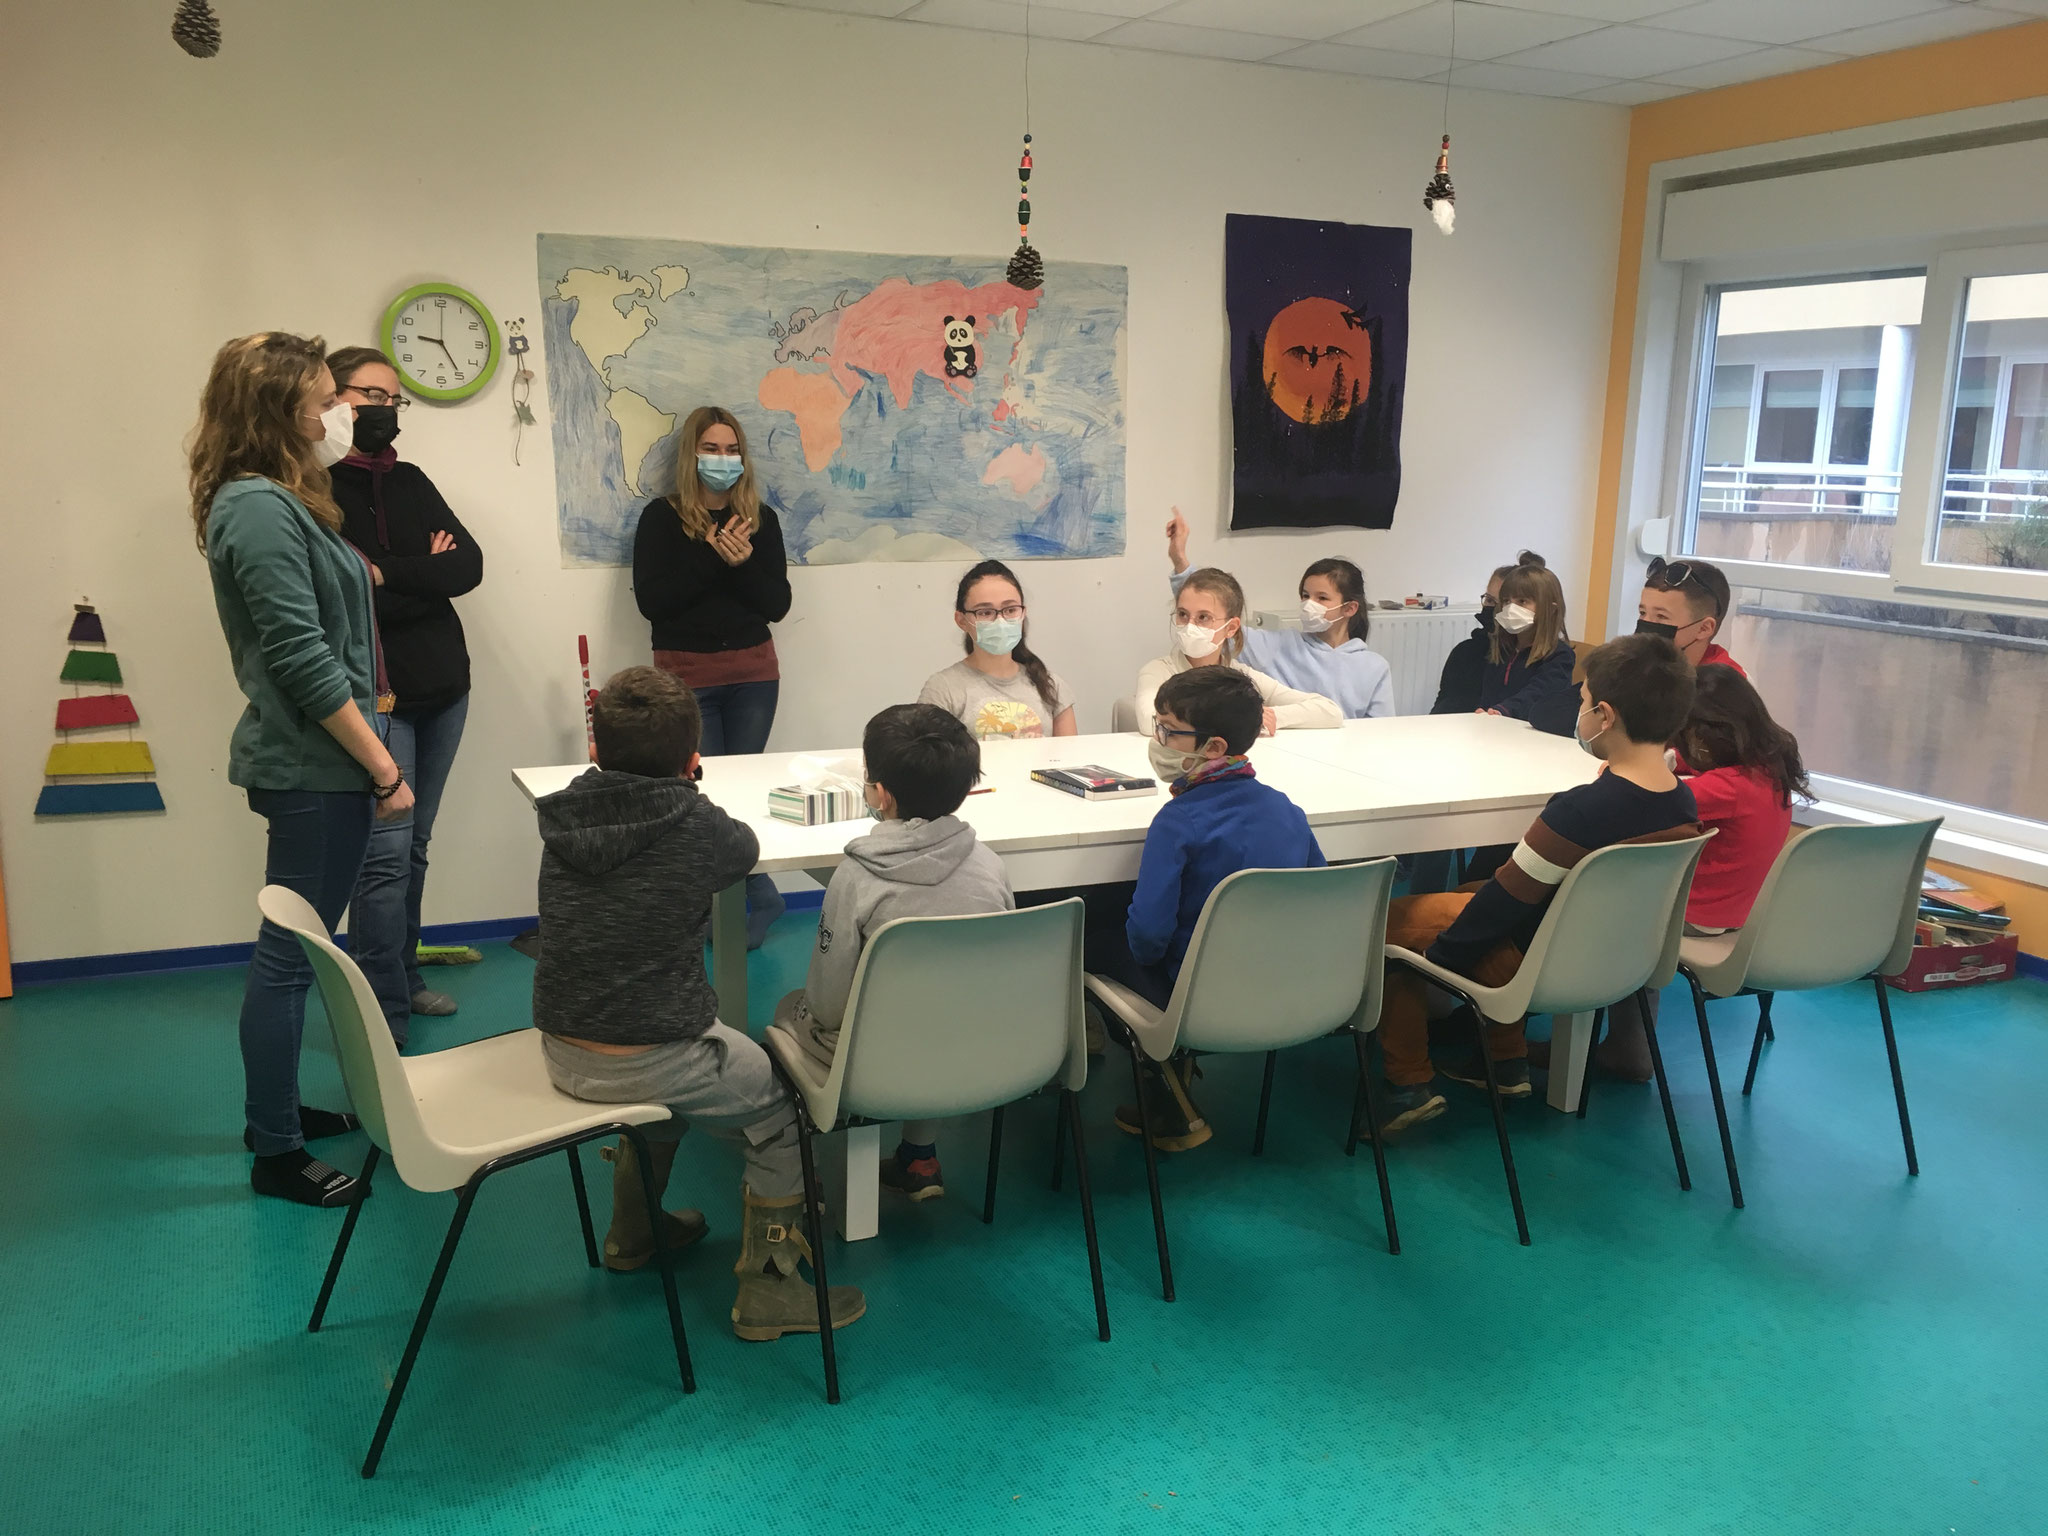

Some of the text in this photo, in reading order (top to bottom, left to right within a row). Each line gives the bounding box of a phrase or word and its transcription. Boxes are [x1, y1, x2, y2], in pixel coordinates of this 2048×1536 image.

[416, 304, 425, 312] 11
[434, 300, 447, 308] 12
[402, 317, 414, 325] 10
[468, 322, 479, 330] 2
[397, 335, 407, 343] 9
[475, 341, 484, 349] 3
[403, 354, 412, 362] 8
[468, 358, 478, 367] 4
[436, 376, 446, 384] 6
[454, 372, 464, 380] 5
